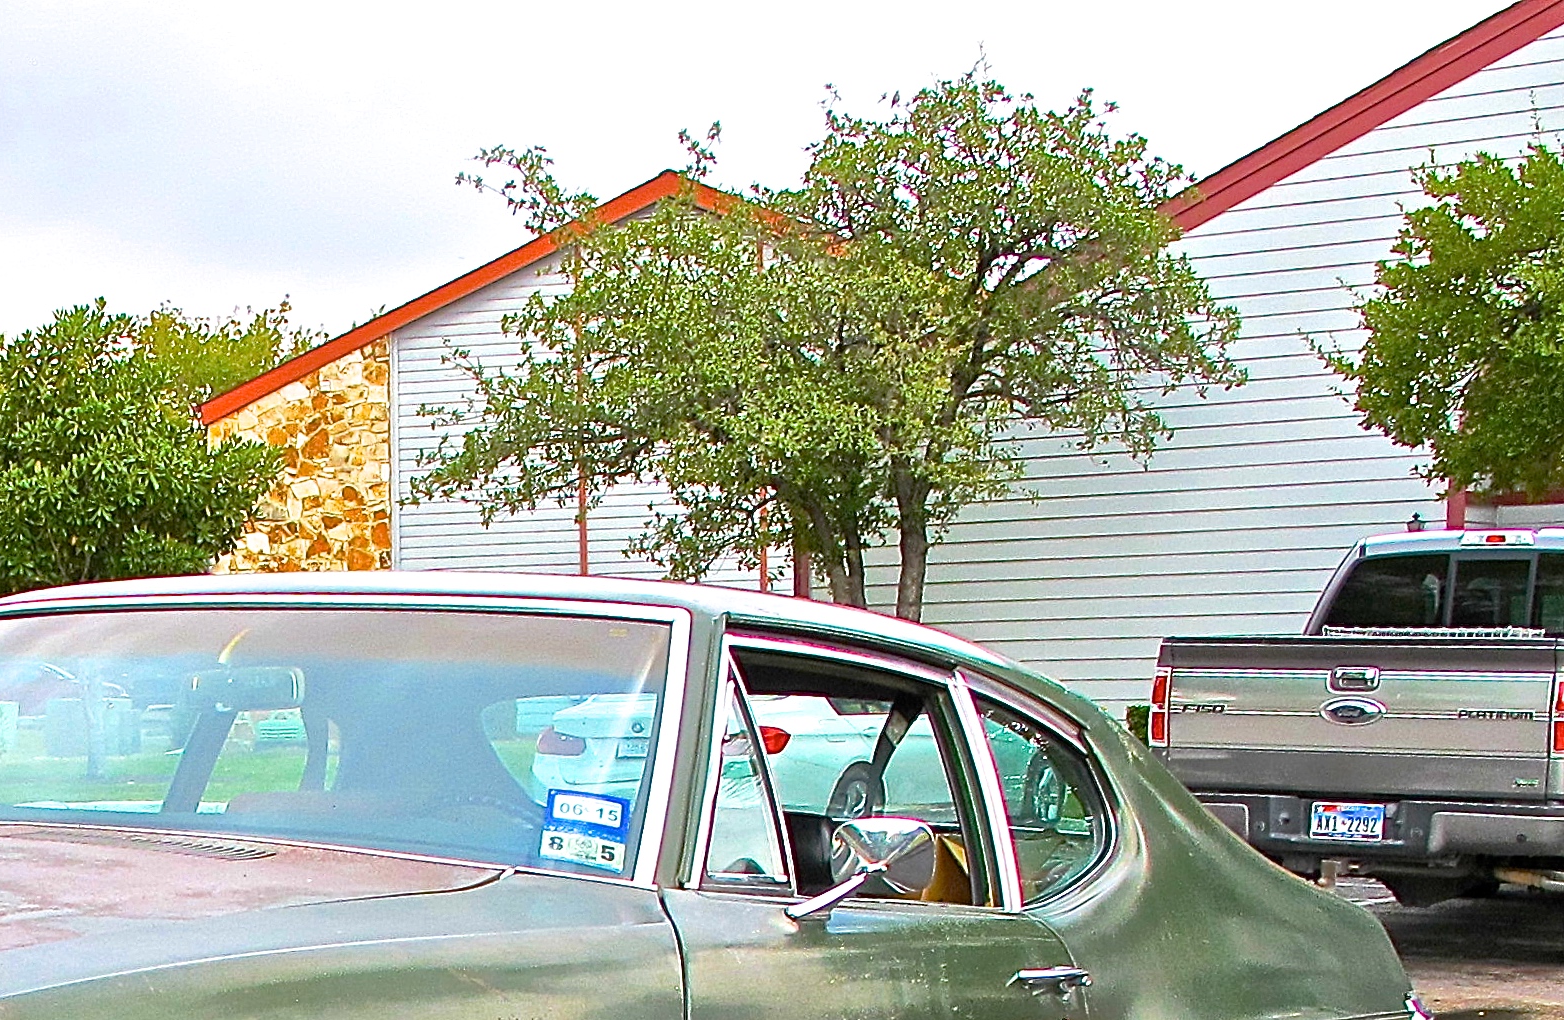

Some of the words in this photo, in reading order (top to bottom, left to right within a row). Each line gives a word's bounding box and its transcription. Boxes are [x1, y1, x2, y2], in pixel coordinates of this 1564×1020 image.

[559, 802, 584, 816] 06
[596, 807, 618, 822] 15
[1347, 816, 1377, 833] 2292
[601, 844, 615, 862] 5
